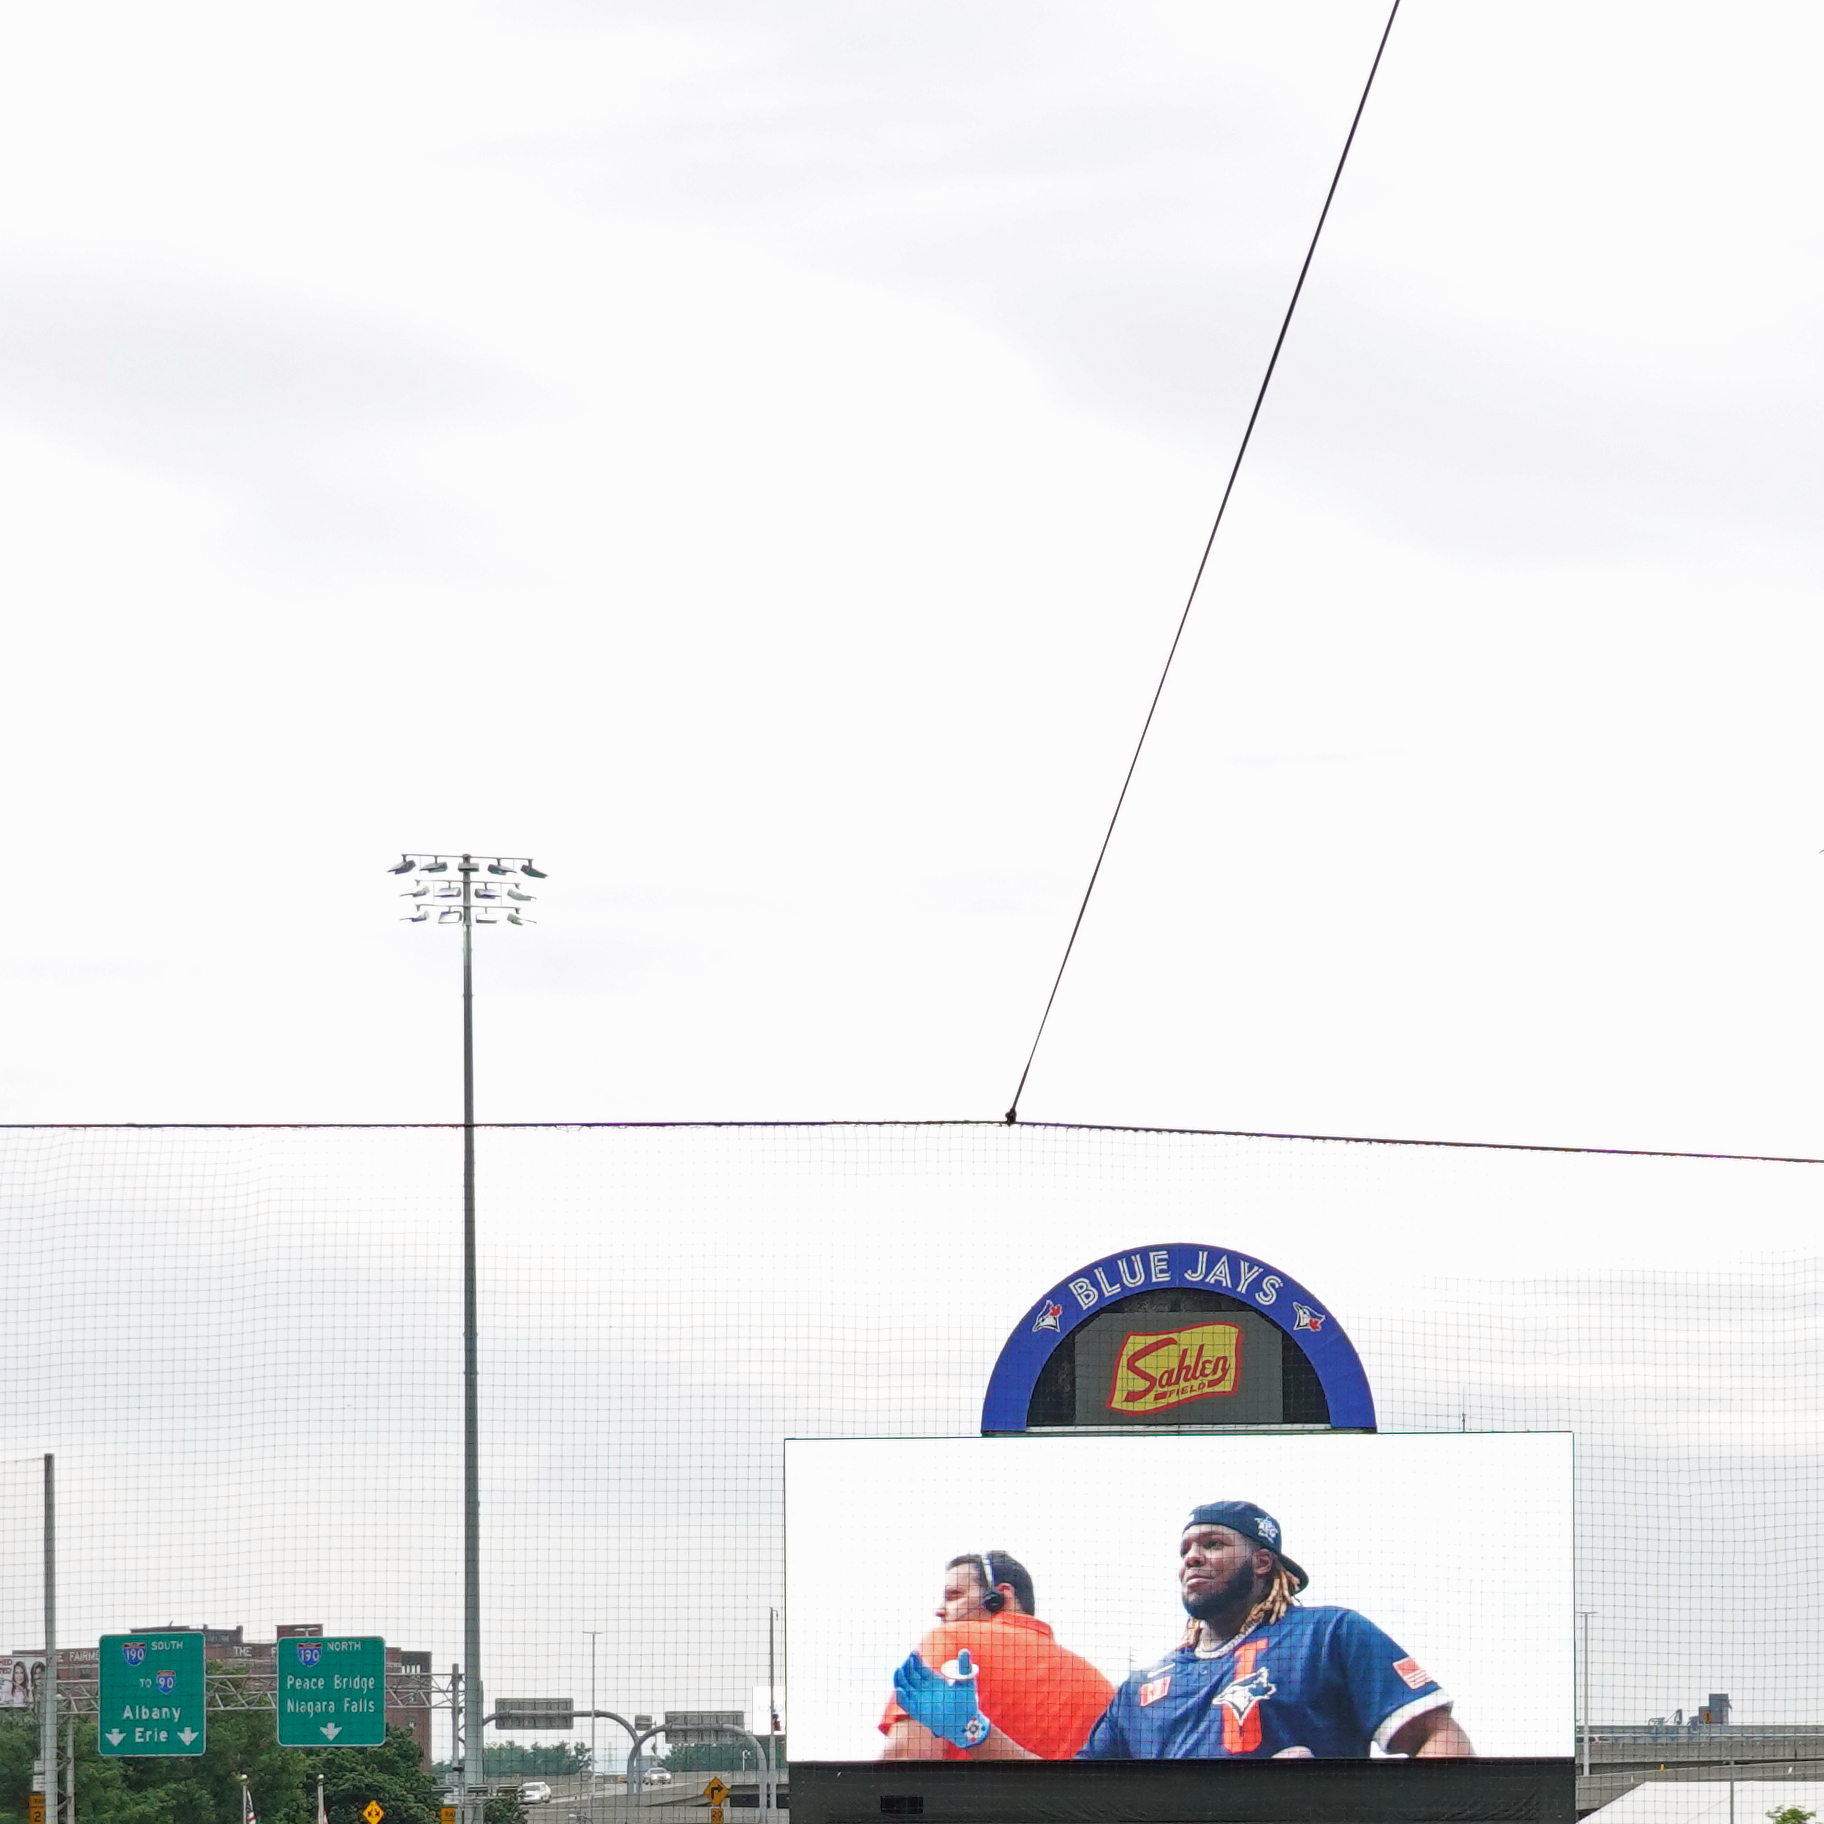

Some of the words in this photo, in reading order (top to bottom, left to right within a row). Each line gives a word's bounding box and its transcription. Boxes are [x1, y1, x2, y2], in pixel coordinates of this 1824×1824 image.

[1069, 1251, 1172, 1310] BLUE
[1184, 1251, 1283, 1305] JAYS
[1123, 1337, 1231, 1403] Sahlen
[1166, 1381, 1206, 1397] FIELD
[126, 1649, 144, 1660] 190
[151, 1641, 184, 1650] SOUTH
[300, 1649, 320, 1661] 190
[327, 1641, 362, 1651] NORTH
[139, 1678, 152, 1688] TO
[158, 1677, 174, 1689] 90
[287, 1675, 325, 1690] Peace
[334, 1674, 375, 1693] Bridge
[122, 1705, 182, 1722] Albany
[287, 1698, 335, 1717] Niagara
[344, 1698, 375, 1713] Falls
[134, 1727, 168, 1743] Erie
